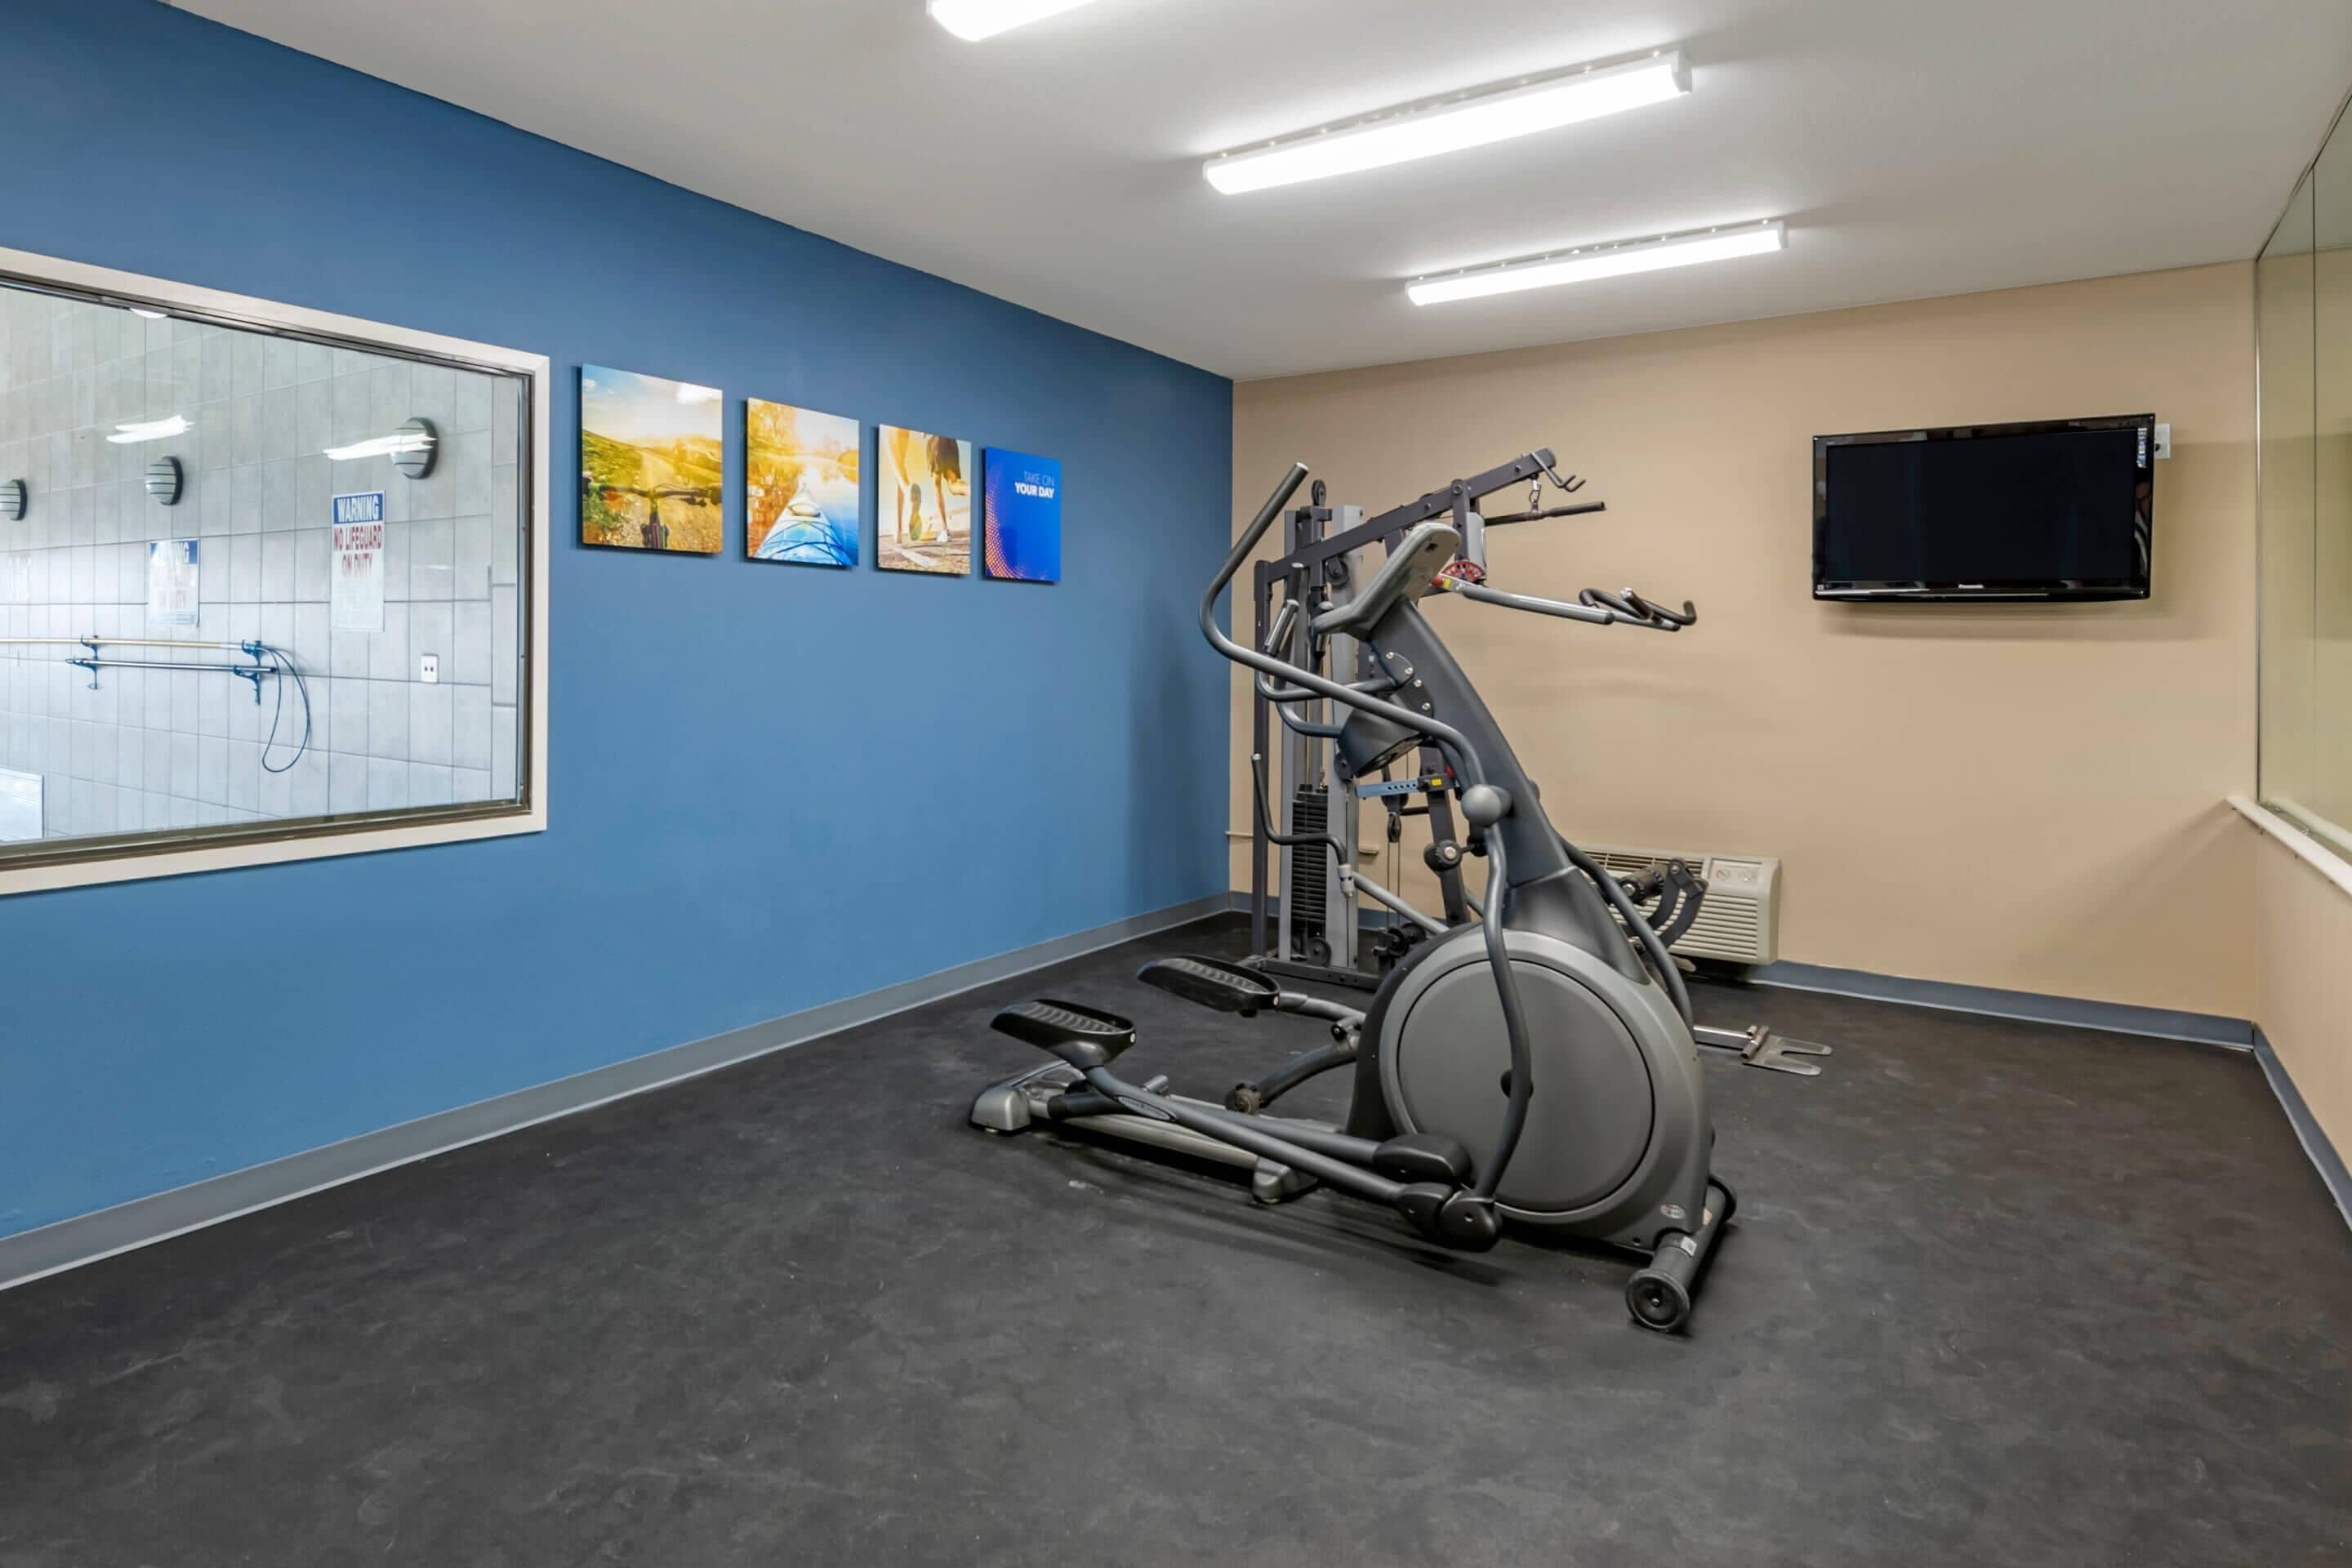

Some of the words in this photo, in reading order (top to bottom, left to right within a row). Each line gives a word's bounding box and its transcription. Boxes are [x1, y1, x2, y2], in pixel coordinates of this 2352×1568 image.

[1014, 481, 1037, 497] YOUR
[1038, 486, 1054, 498] DAY
[1024, 470, 1040, 485] TAKE
[1042, 475, 1054, 487] ON
[337, 495, 379, 523] WARNING
[333, 527, 343, 550] NO
[345, 524, 381, 550] LIFEGUARD
[342, 555, 352, 576] ON
[354, 553, 373, 576] DUTY
